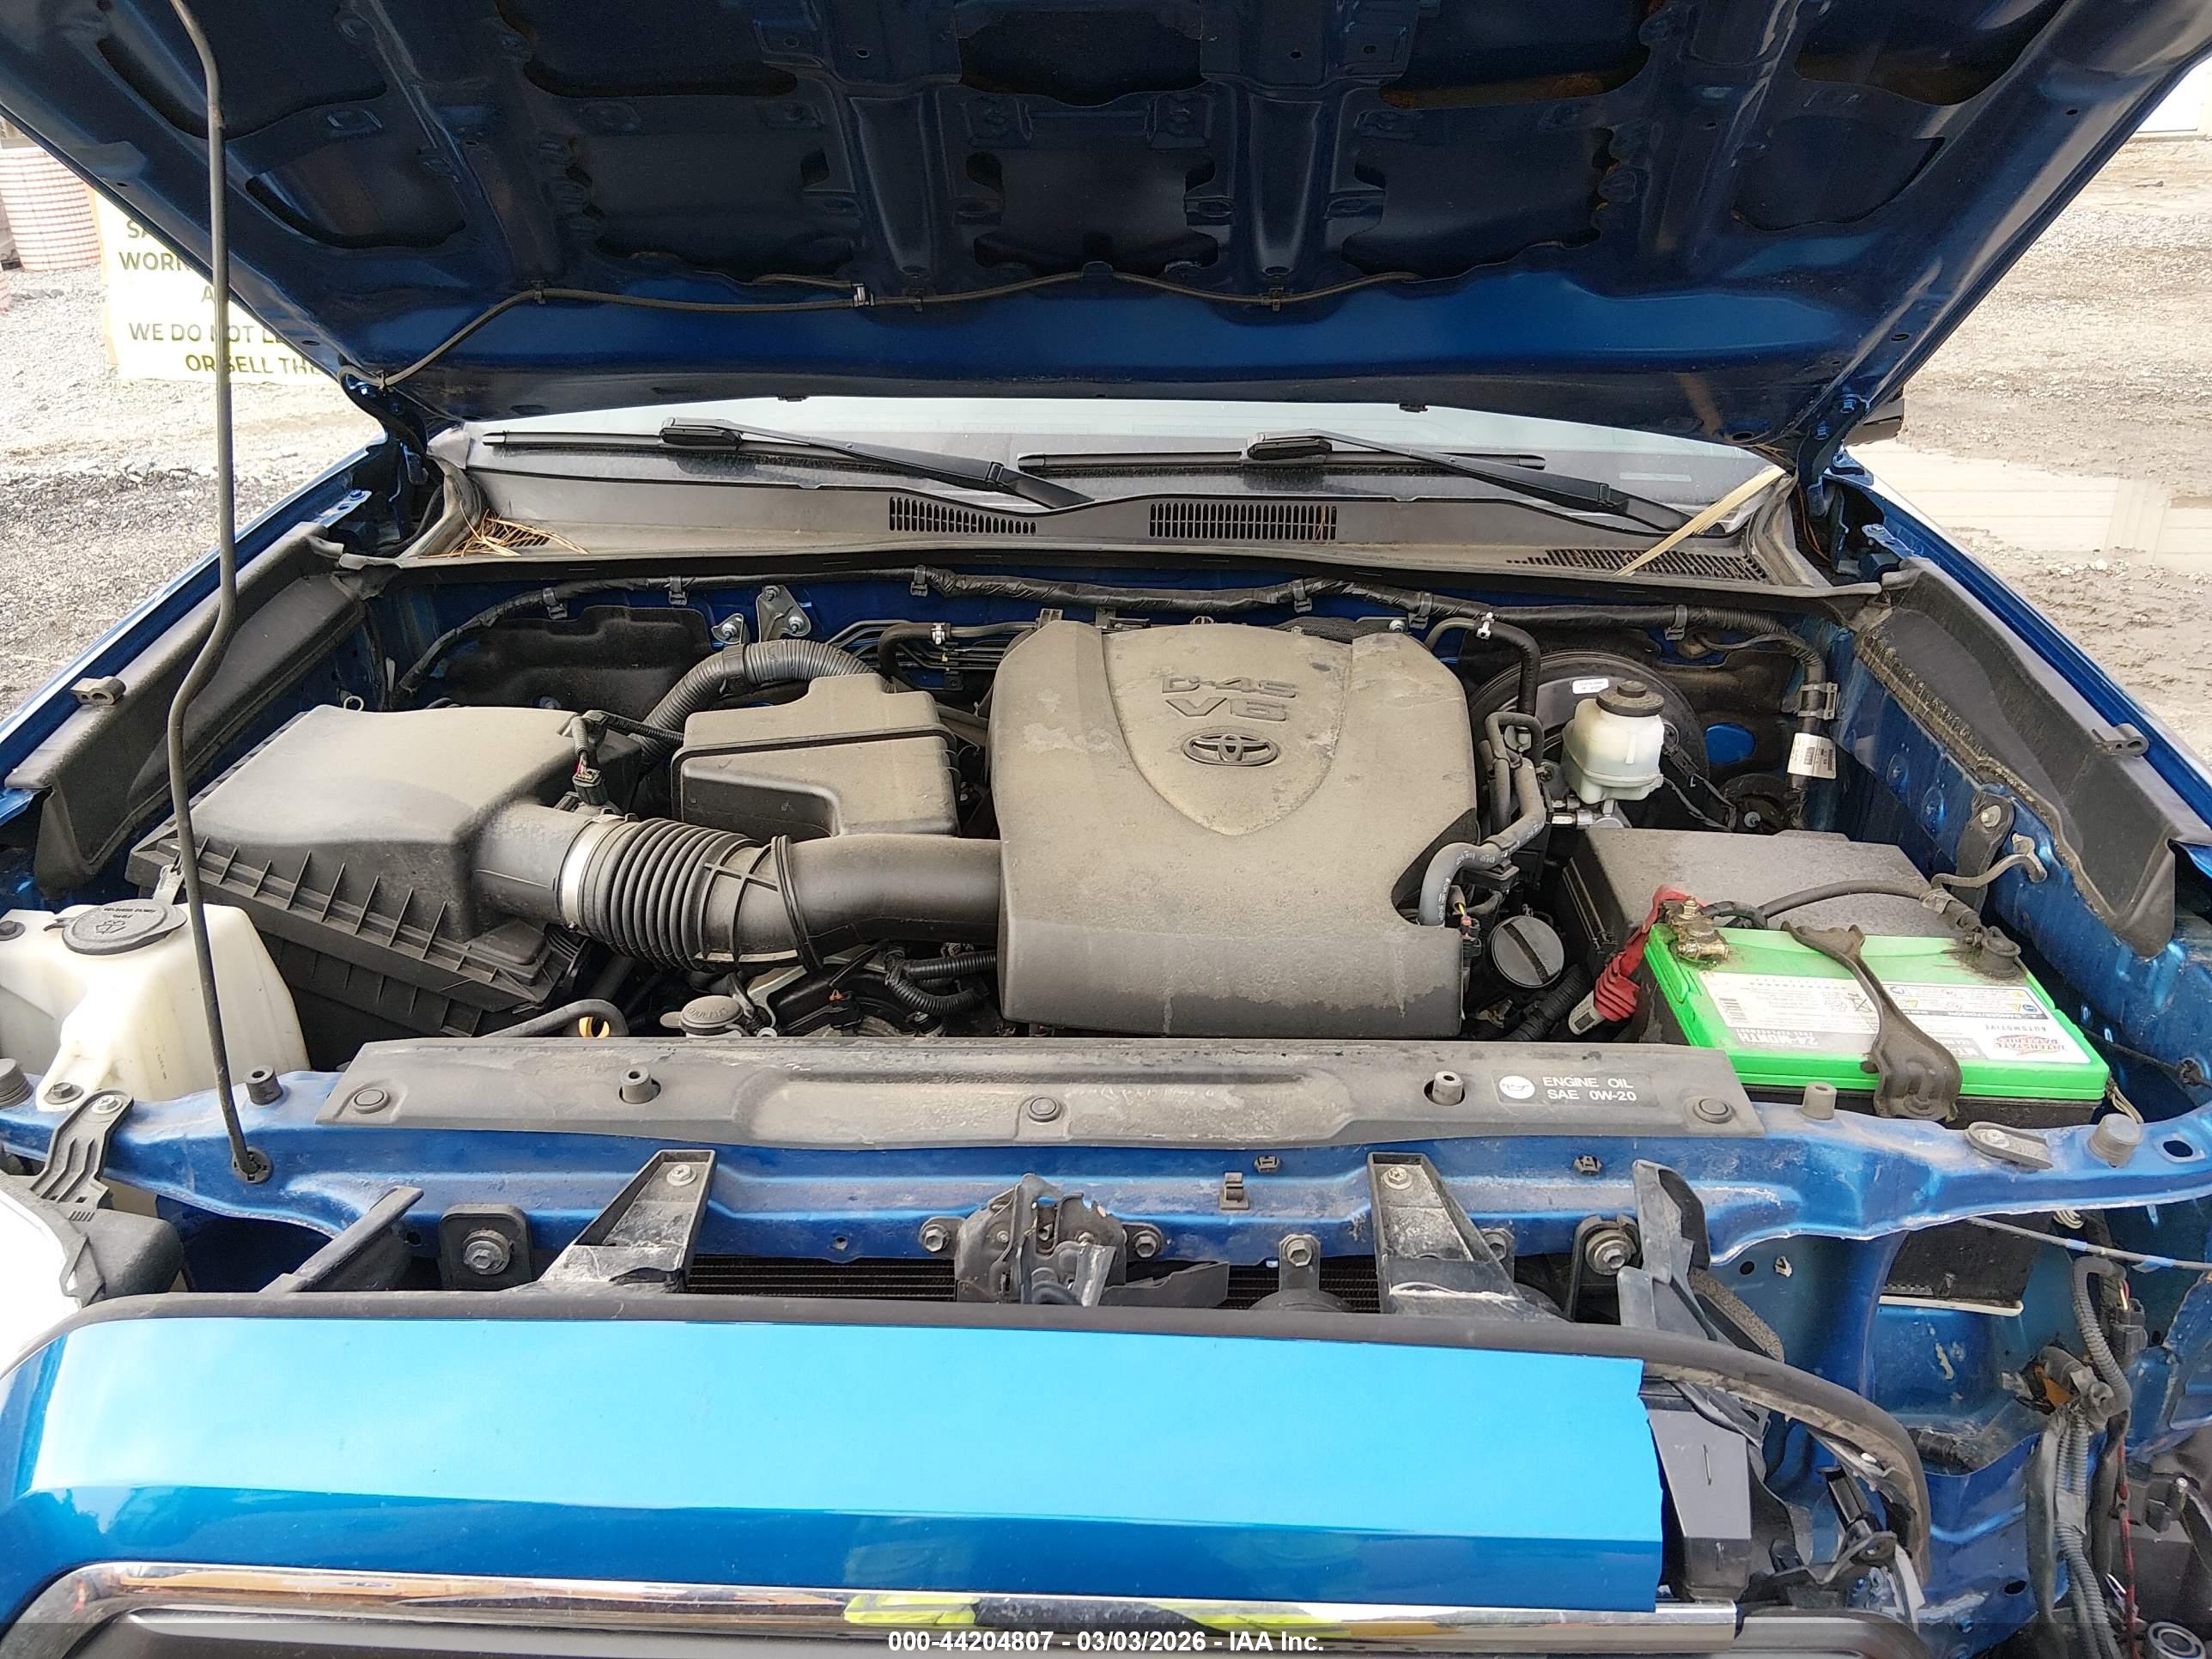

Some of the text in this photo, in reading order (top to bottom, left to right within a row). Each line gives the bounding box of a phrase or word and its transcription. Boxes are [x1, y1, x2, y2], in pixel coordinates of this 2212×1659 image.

[129, 323, 164, 340] WE
[171, 324, 202, 342] DO
[185, 354, 216, 372] OR
[1164, 696, 1287, 722] V6
[1542, 1077, 1634, 1089] ENGINE OIL
[1547, 1089, 1638, 1102] SAE 0W-20
